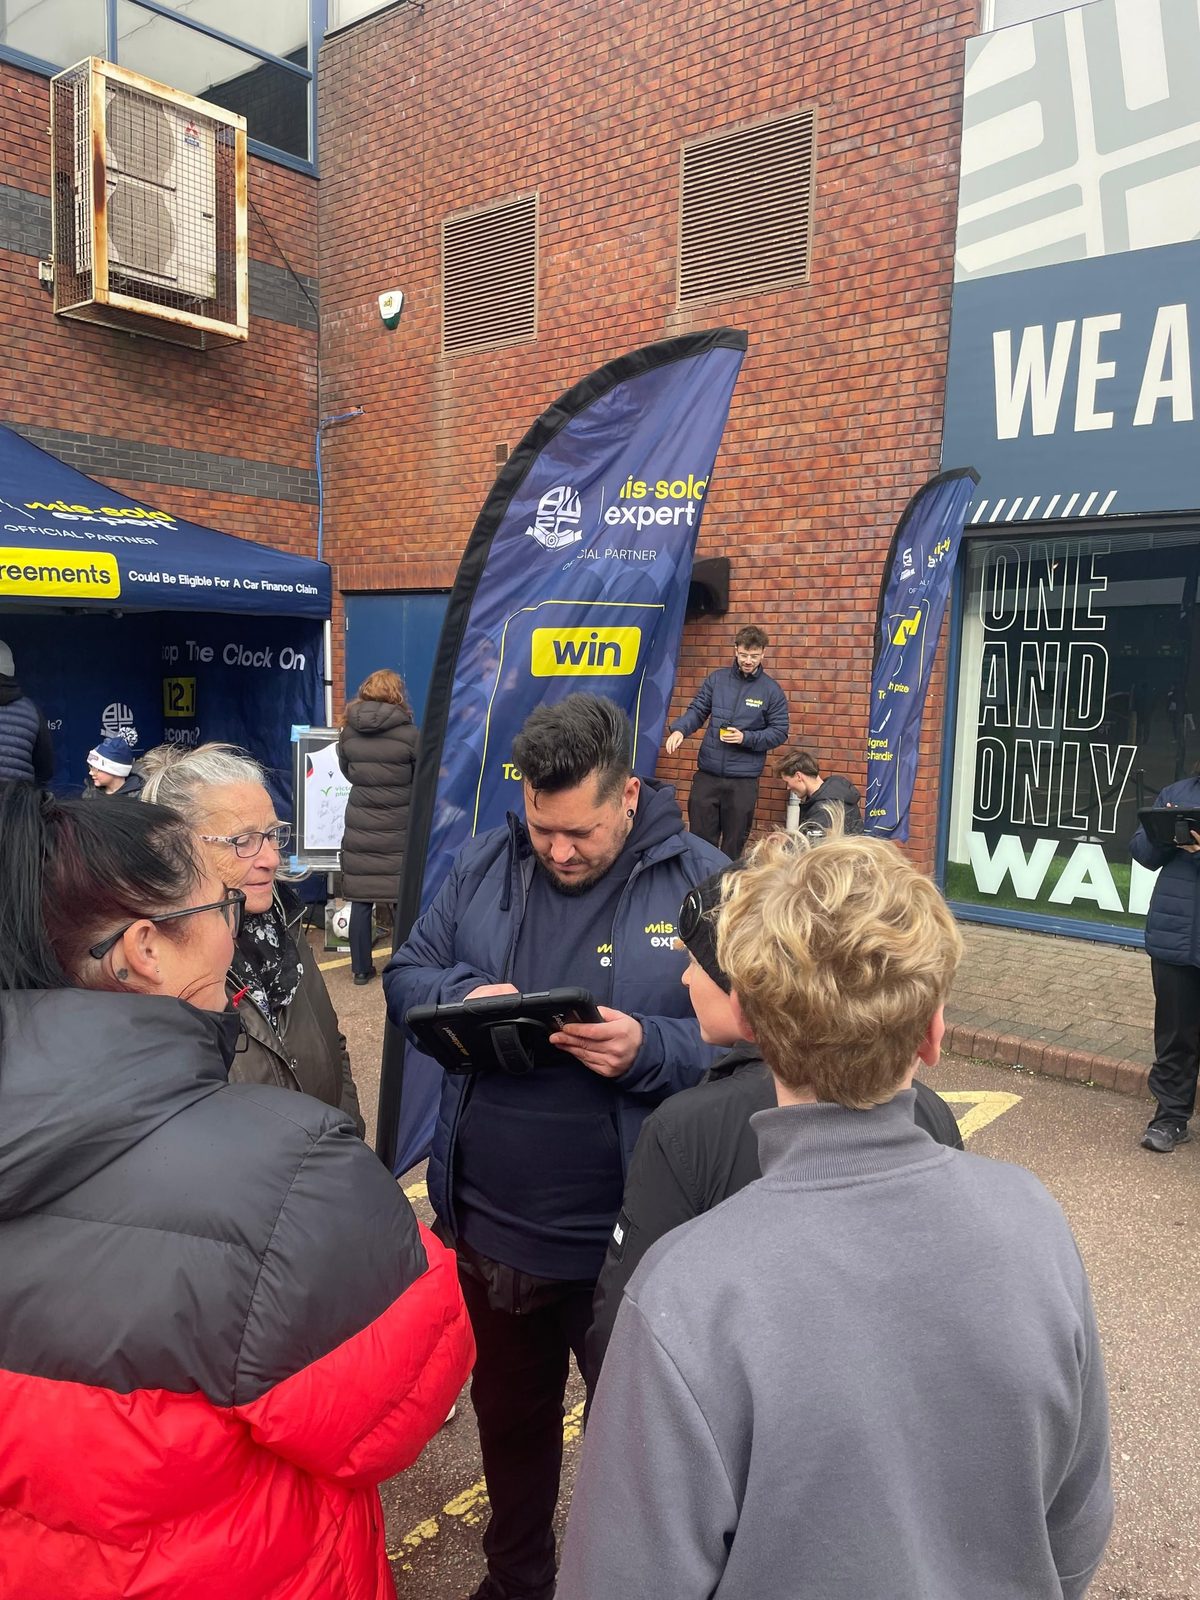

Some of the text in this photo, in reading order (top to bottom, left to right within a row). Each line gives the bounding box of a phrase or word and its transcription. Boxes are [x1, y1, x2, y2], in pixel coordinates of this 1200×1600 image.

[993, 303, 1194, 440] WE A
[620, 474, 709, 500] is-sold
[24, 500, 177, 522] mis-sold
[52, 511, 178, 531] expert
[604, 501, 696, 531] expert
[4, 524, 159, 546] OFFICIAL PARTNER
[604, 548, 657, 561] PARTNER
[0, 564, 111, 584] reements
[128, 570, 318, 595] Could Be Eligible For A Car Finance Claim
[979, 542, 1111, 631] ONE
[161, 645, 179, 666] op
[222, 643, 273, 668] Clock
[279, 647, 306, 671] On
[552, 632, 622, 667] win
[978, 641, 1109, 731] AND
[868, 737, 888, 749] igned
[971, 736, 1138, 834] ONLY
[644, 921, 678, 934] mis-
[650, 936, 681, 951] exp
